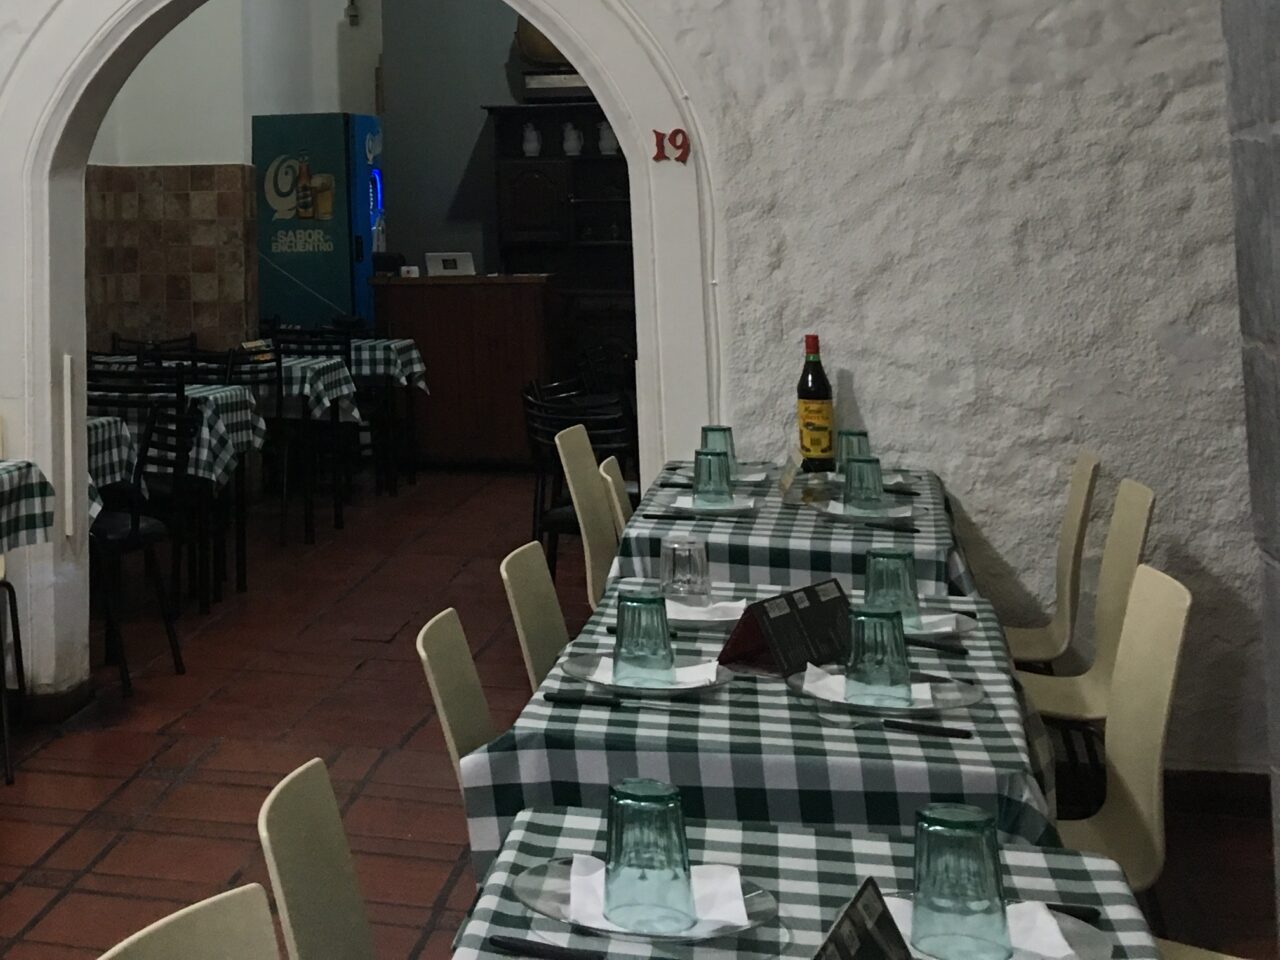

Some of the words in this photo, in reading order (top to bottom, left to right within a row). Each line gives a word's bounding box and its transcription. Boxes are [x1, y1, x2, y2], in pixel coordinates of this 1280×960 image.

[652, 128, 691, 167] 19
[277, 230, 324, 242] SABOR
[272, 241, 334, 252] ENCUENTRO
